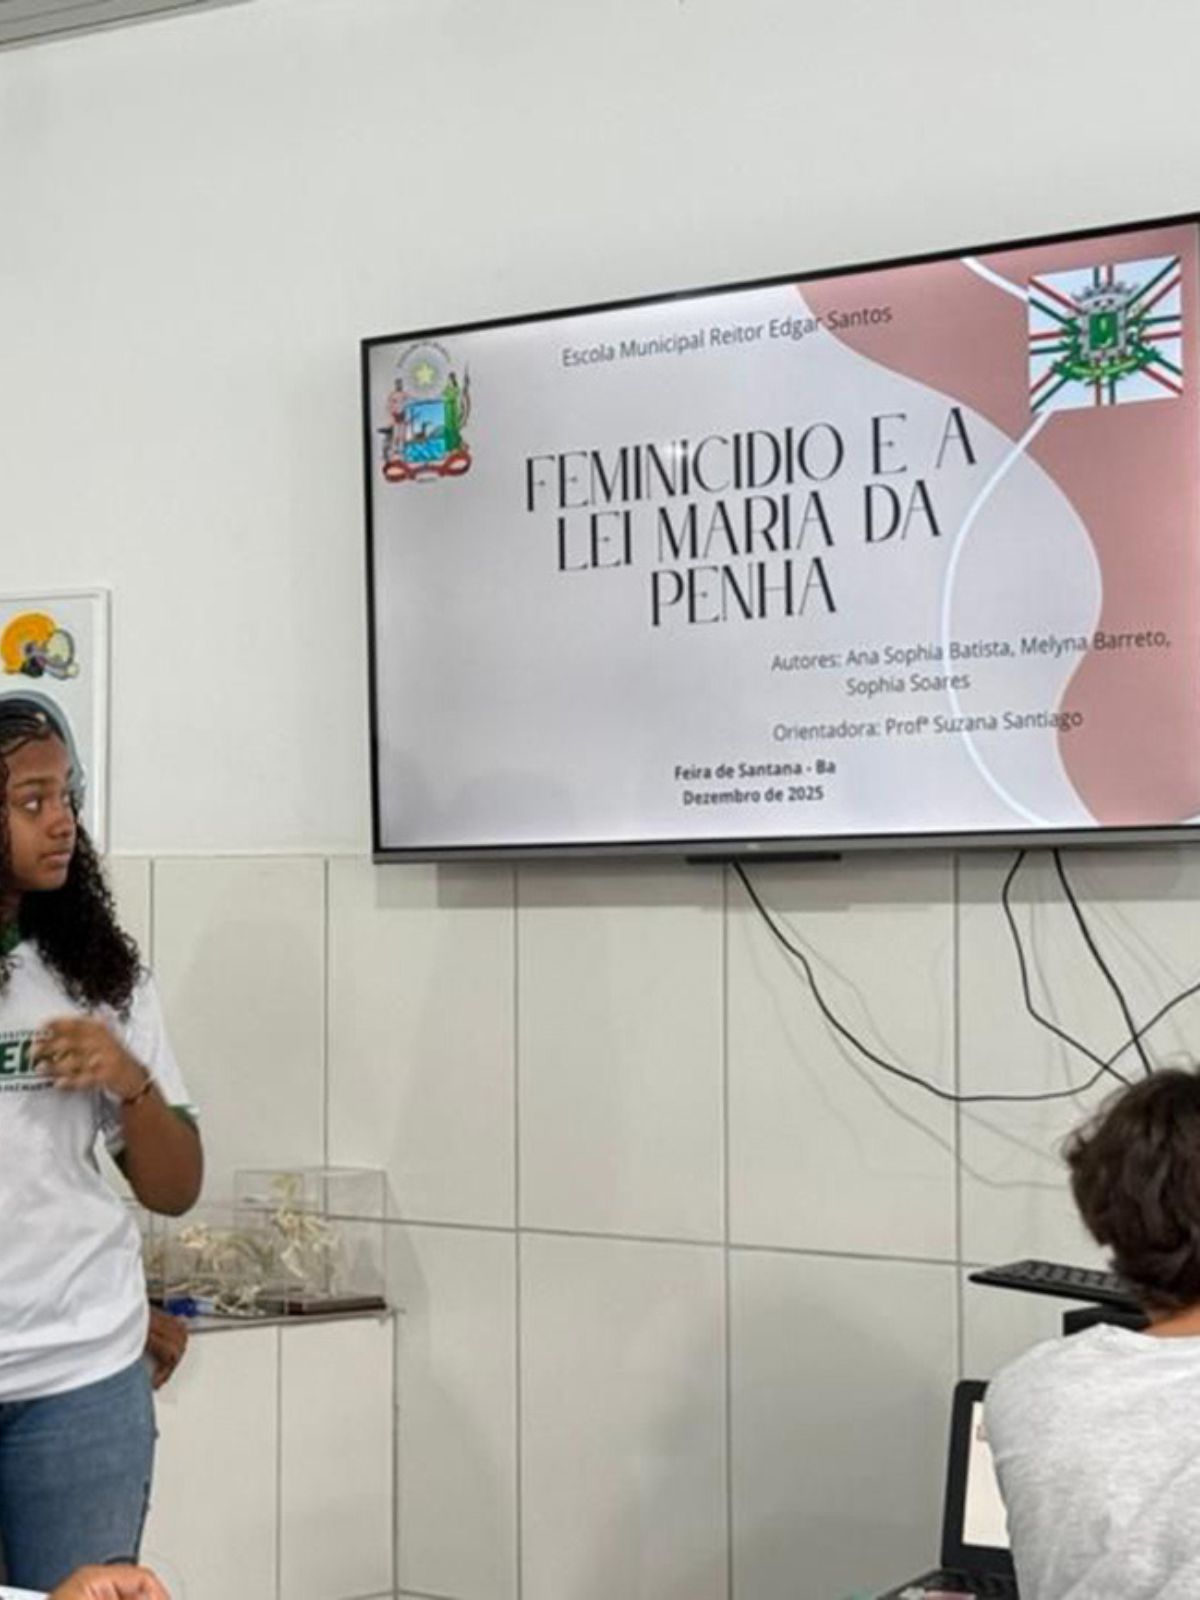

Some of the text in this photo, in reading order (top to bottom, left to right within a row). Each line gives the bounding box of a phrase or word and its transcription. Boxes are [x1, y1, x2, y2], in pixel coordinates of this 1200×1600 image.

[562, 305, 893, 367] Escola Municipal Reitor Edgar Santos
[871, 413, 908, 475] E
[935, 407, 977, 468] A
[557, 479, 941, 571] LEI MARIA DA
[651, 556, 837, 626] PENHA
[771, 628, 1172, 672] Autores: Ana Sophia Batista, Melyna Barreto,
[845, 672, 971, 700] Sophia Soares
[772, 719, 882, 742] Orientadora:
[933, 715, 999, 735] Suzana
[1002, 709, 1084, 733] Santiago
[674, 764, 712, 781] Feira
[714, 762, 735, 779] de
[738, 761, 803, 778] Santana
[815, 758, 836, 775] Ba
[682, 784, 825, 807] Dezembro de 2025
